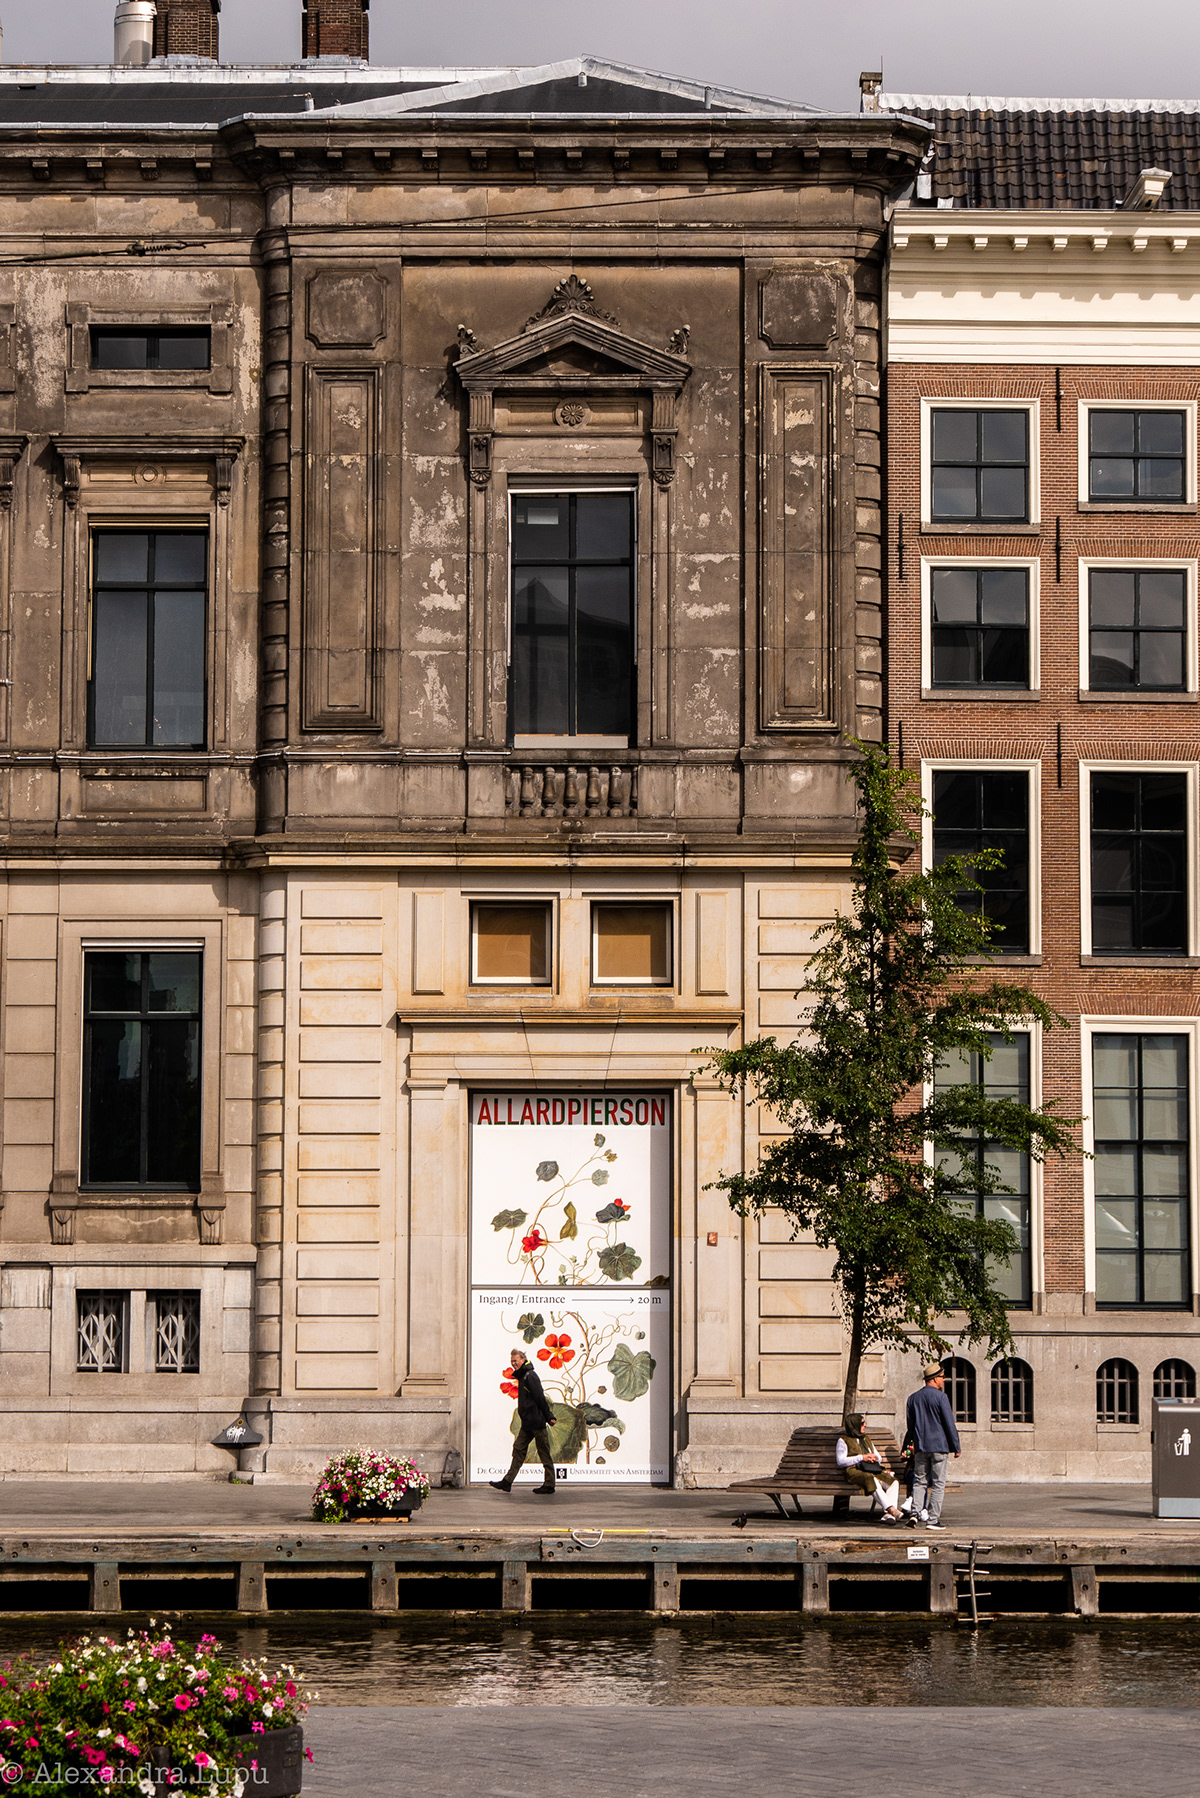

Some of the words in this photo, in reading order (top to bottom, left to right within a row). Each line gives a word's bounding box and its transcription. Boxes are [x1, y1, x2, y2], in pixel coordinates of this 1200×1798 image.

[477, 1097, 665, 1126] ALLARDPIERSON
[479, 1294, 514, 1305] Ingang
[515, 1294, 521, 1305] /
[521, 1294, 566, 1304] Entrance
[637, 1296, 650, 1305] 20
[651, 1296, 662, 1304] m
